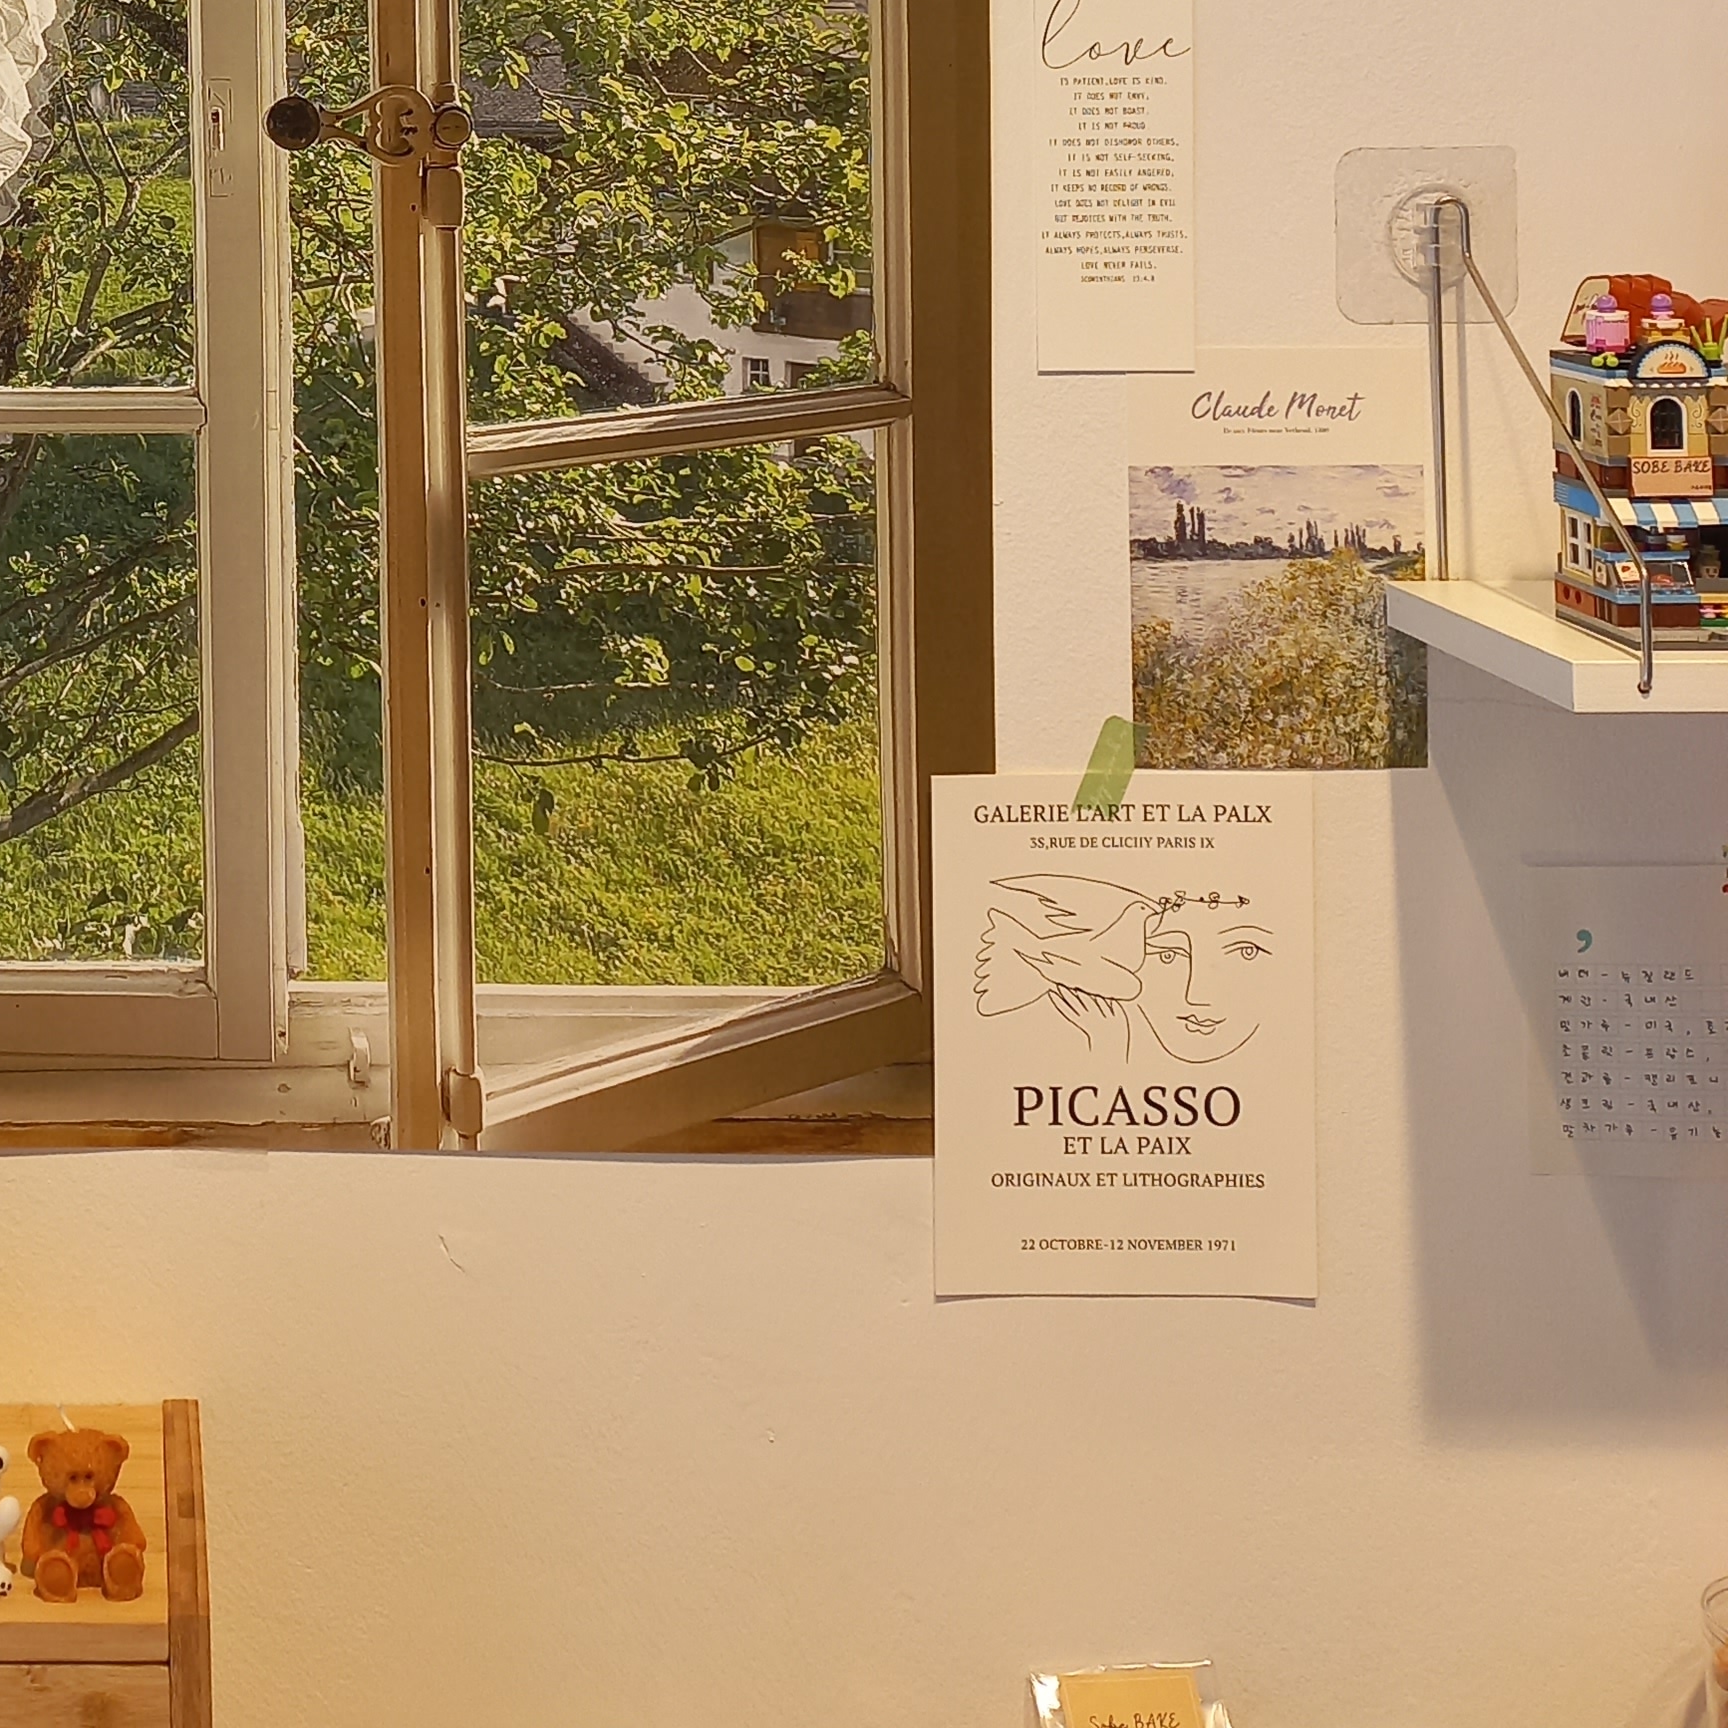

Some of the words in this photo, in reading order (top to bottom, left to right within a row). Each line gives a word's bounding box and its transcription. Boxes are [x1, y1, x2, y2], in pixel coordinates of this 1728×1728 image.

[1073, 92, 1082, 101] IT
[1069, 107, 1077, 116] IT
[1078, 122, 1087, 131] IT
[1091, 122, 1101, 131] IS
[1104, 122, 1118, 131] NOT
[1062, 138, 1081, 147] DOES
[1085, 138, 1100, 147] NOT
[1081, 153, 1091, 162] IS
[1095, 153, 1109, 162] NOT
[1058, 168, 1067, 178] IT
[1085, 168, 1100, 178] NOT
[1104, 168, 1133, 178] EASILY
[1050, 183, 1059, 193] IT
[1130, 183, 1139, 193] OF
[1054, 198, 1072, 208] LOVE
[1108, 214, 1127, 223] WITH
[1131, 214, 1144, 223] THE
[1053, 230, 1082, 240] ALWAYS
[1045, 245, 1073, 255] ALWAYS
[1080, 261, 1099, 271] LOVE
[1191, 389, 1280, 421] Claude
[1284, 390, 1366, 422] Monet
[1632, 459, 1671, 474] SOBE
[1674, 459, 1711, 473] BAKE
[973, 804, 1070, 824] GALERIE
[1075, 804, 1136, 823] L'ART
[1141, 804, 1171, 823] ET
[1176, 804, 1207, 823] LA
[1213, 804, 1273, 824] PALX
[1080, 836, 1099, 849] DE
[1156, 836, 1197, 849] PARIS
[1199, 836, 1216, 849] IX
[1013, 1085, 1241, 1127] PICASSO
[1063, 1136, 1092, 1155] ET
[1100, 1136, 1130, 1155] LA
[1136, 1136, 1192, 1155] PAIX
[991, 1172, 1091, 1188] ORIGINAUX
[1096, 1172, 1118, 1187] ET
[1123, 1172, 1265, 1189] LITHOGRAPHIES
[1020, 1238, 1036, 1251] 22
[1127, 1238, 1203, 1252] NOVEMBER
[1207, 1238, 1237, 1252] 1971
